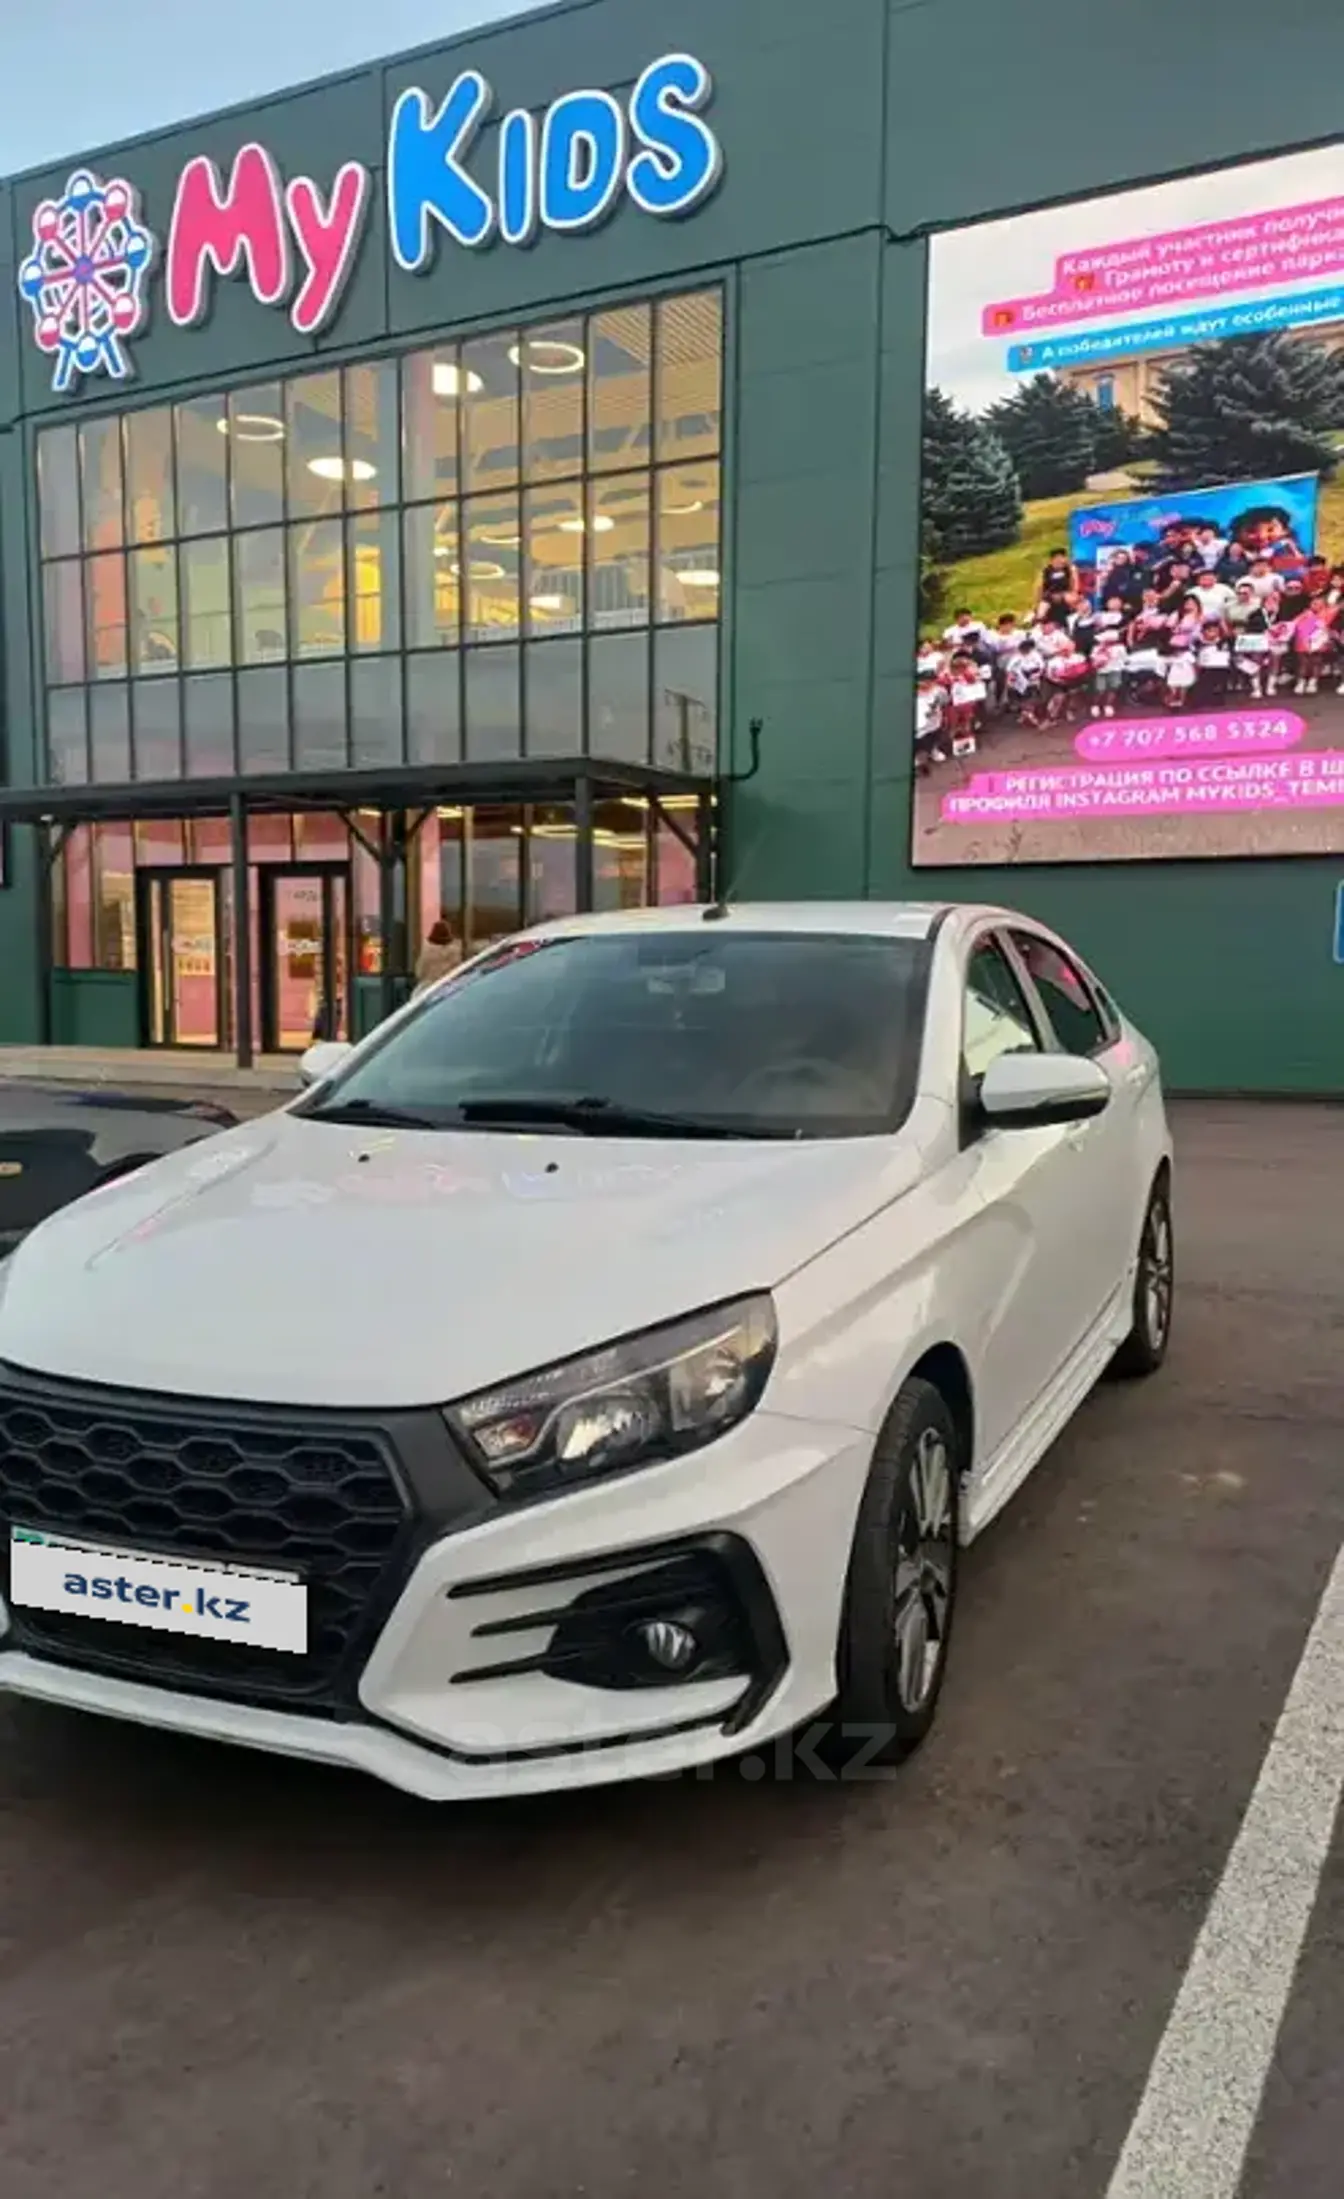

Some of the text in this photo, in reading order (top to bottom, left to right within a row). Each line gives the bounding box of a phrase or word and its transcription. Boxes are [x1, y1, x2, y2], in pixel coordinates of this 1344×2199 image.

[1063, 242, 1151, 275] Каждый
[1155, 226, 1257, 261] участник
[1105, 258, 1196, 288] Грамоту
[1199, 255, 1215, 268] и
[1021, 288, 1142, 321] Бесплатное
[1148, 262, 1276, 299] посещение
[1042, 296, 1340, 360] А победителей ждут особенные
[1089, 731, 1115, 748] +7
[1173, 724, 1218, 743] 568
[1006, 770, 1153, 791] РЕГИСТРАЦИЯ
[1159, 768, 1193, 783] ПО
[1197, 762, 1290, 782] ССЫЛКЕ
[1299, 760, 1315, 777] В
[950, 795, 1049, 812] ПРОФИЛЯ
[1056, 788, 1180, 808] INSTAGRAM
